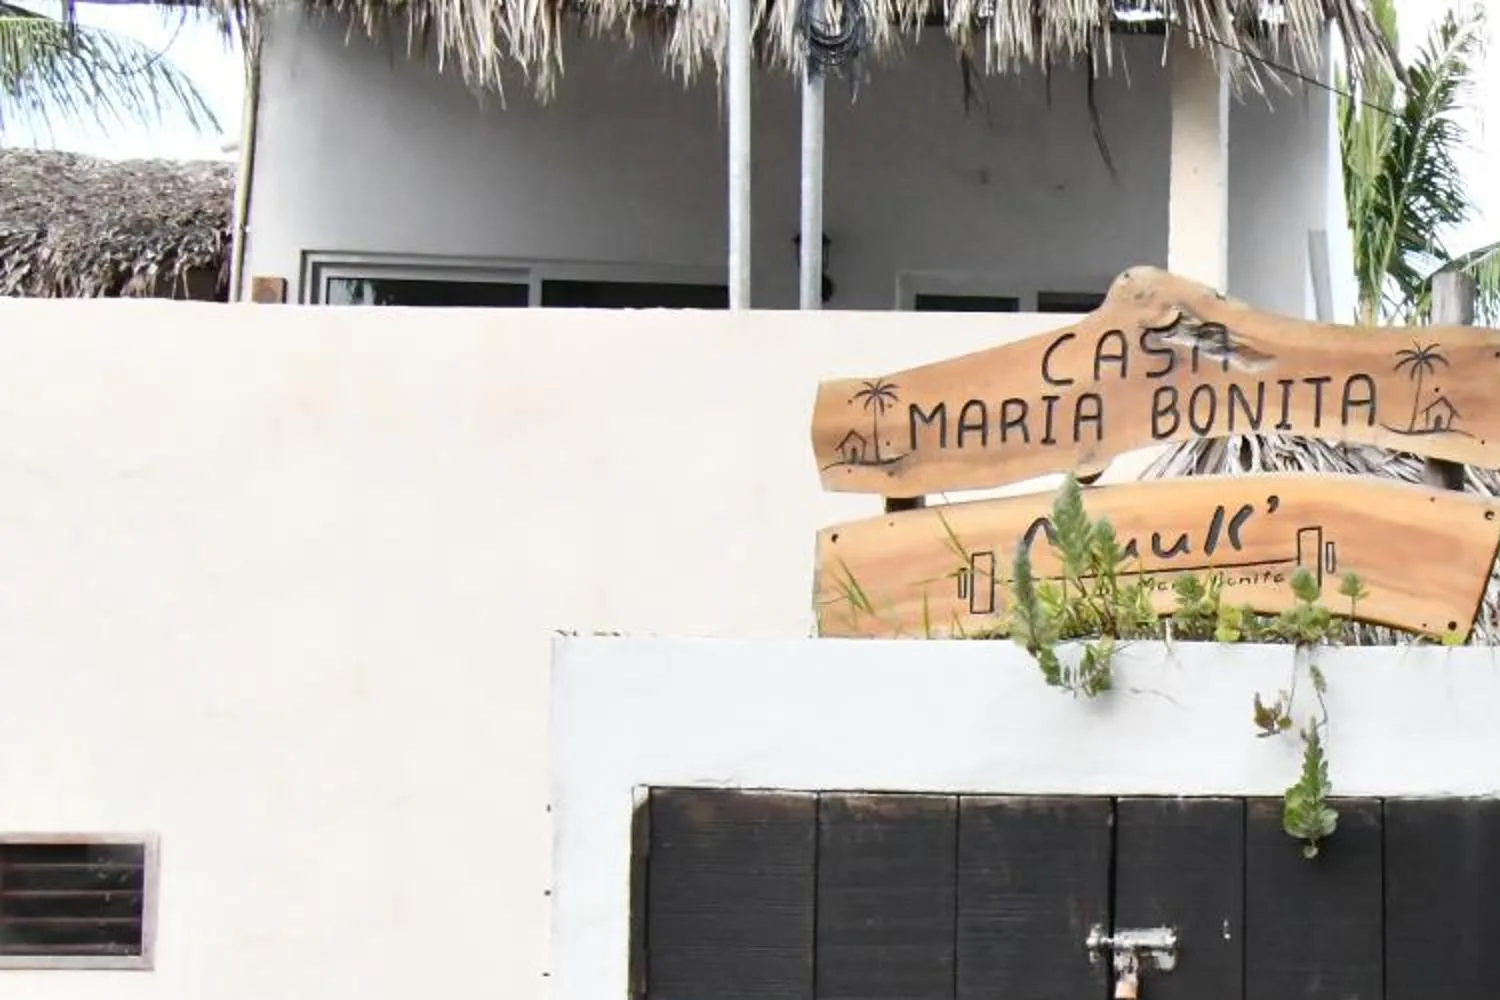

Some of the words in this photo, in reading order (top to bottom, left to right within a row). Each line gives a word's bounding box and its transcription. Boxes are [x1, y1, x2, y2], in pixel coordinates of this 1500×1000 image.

[1042, 313, 1229, 386] CASA
[909, 392, 1104, 451] MARIA
[1151, 374, 1377, 440] BONITA
